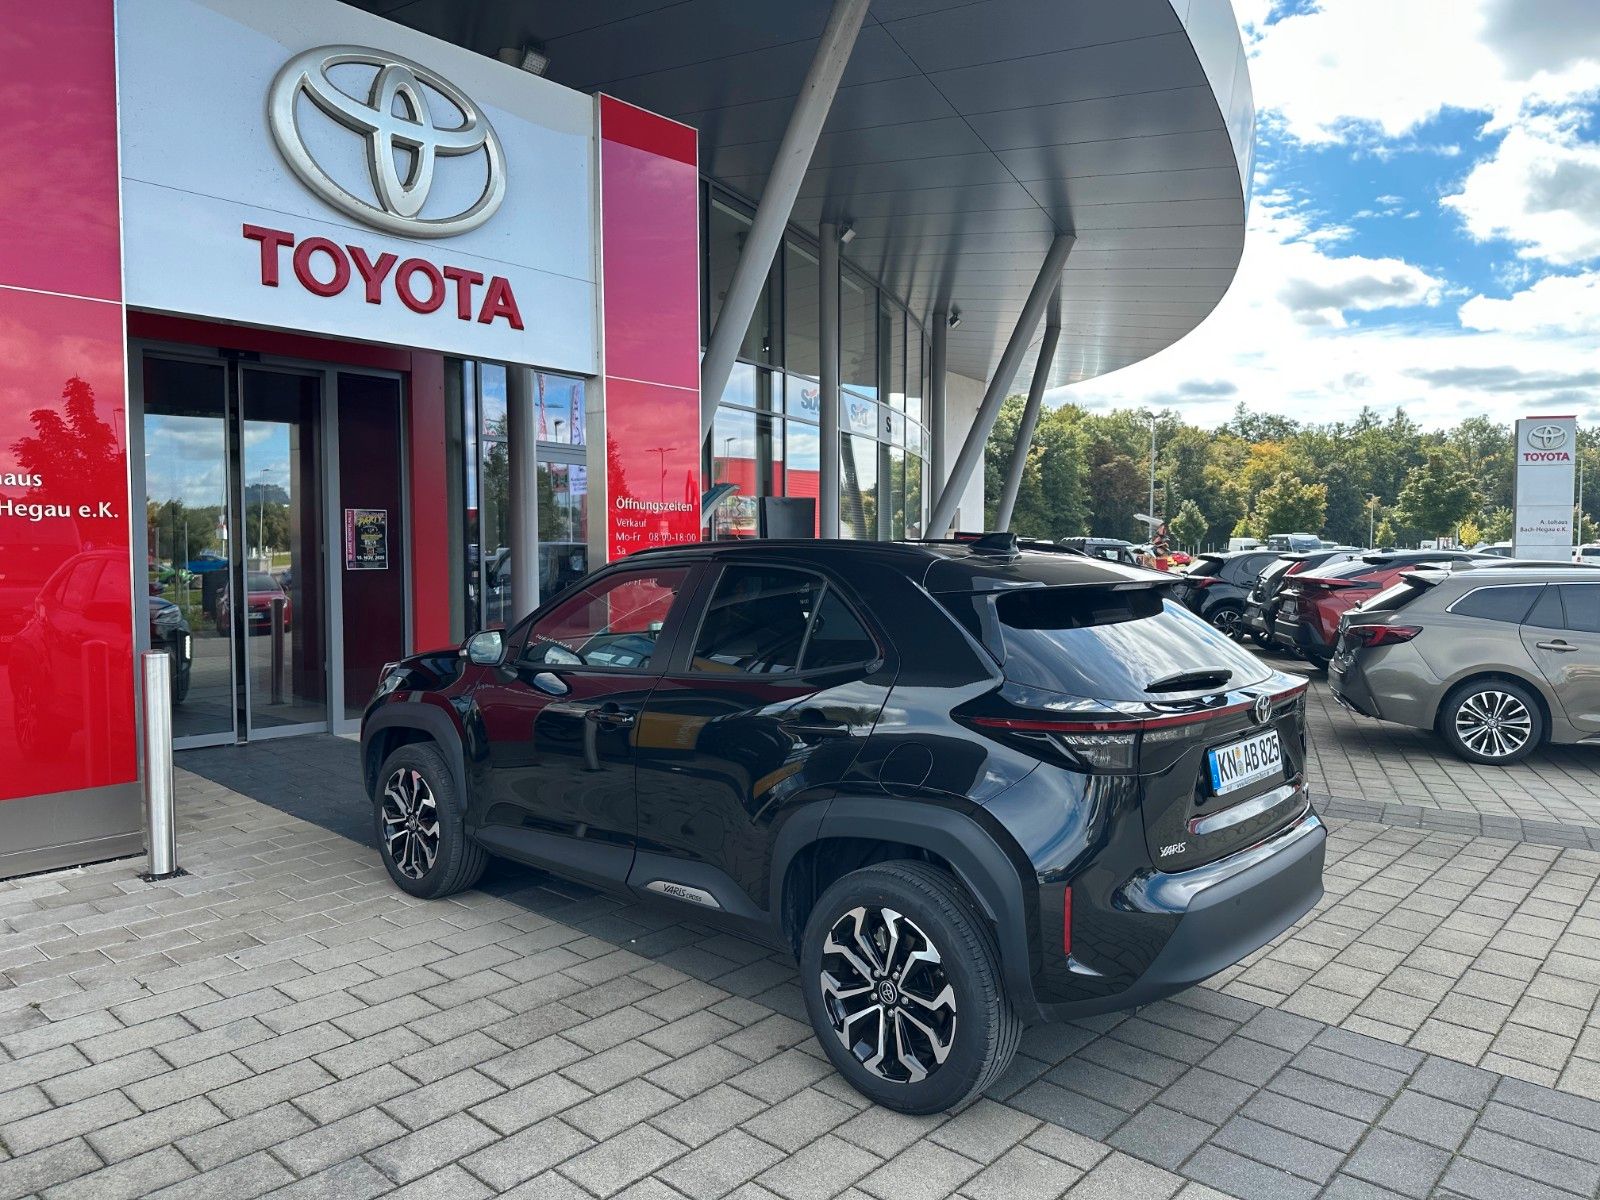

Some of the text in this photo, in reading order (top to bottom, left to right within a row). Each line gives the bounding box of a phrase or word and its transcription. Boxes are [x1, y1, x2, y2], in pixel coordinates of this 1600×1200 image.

[242, 223, 525, 331] TOYOTA
[1523, 452, 1570, 461] TOYOTA
[0, 472, 43, 487] aus
[78, 501, 119, 518] e.K.
[616, 496, 693, 514] Öffnungszeiten
[616, 517, 647, 528] Verkauf
[616, 532, 641, 541] Mo-Fr
[616, 545, 626, 555] Sa
[1217, 750, 1238, 782] KN
[1244, 743, 1260, 773] AB
[1260, 734, 1280, 766] 825
[1160, 842, 1186, 857] YARIS
[663, 883, 702, 902] YARIS CROSS
